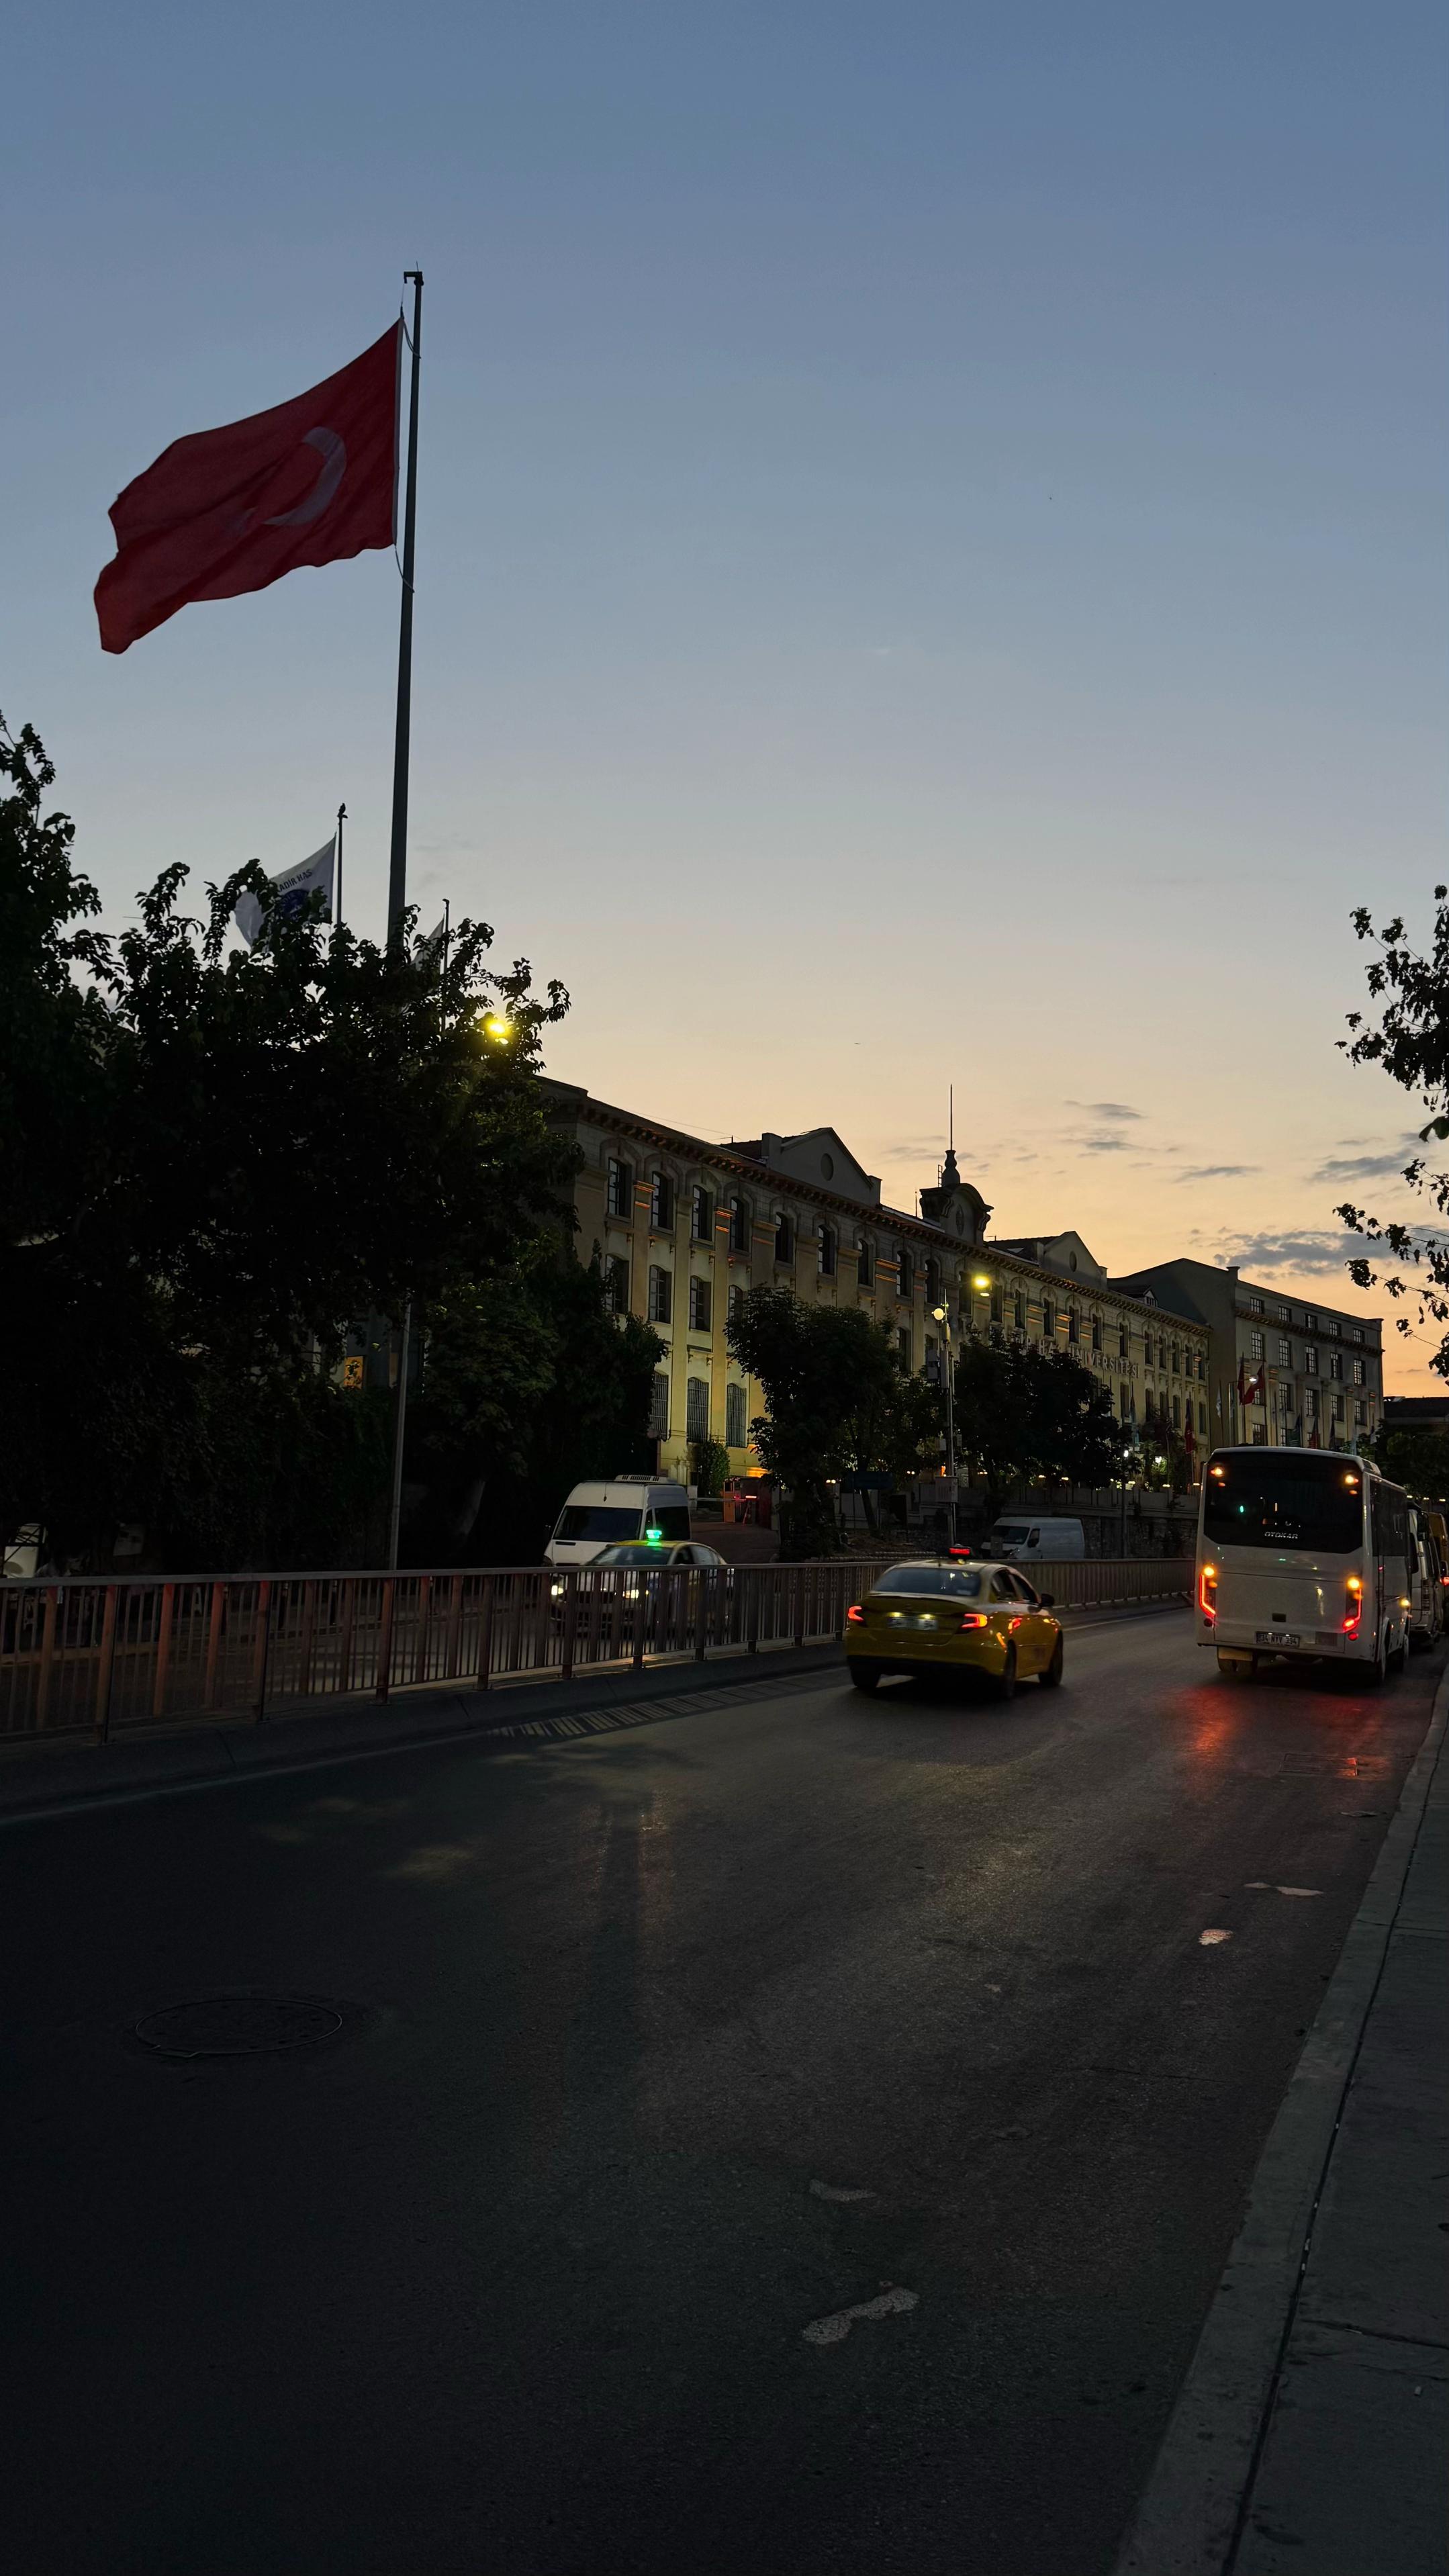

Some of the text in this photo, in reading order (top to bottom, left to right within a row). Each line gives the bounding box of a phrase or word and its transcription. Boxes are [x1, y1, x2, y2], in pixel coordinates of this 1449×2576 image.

[278, 869, 312, 892] ADIR HAS
[1264, 1531, 1299, 1539] OTOKAR
